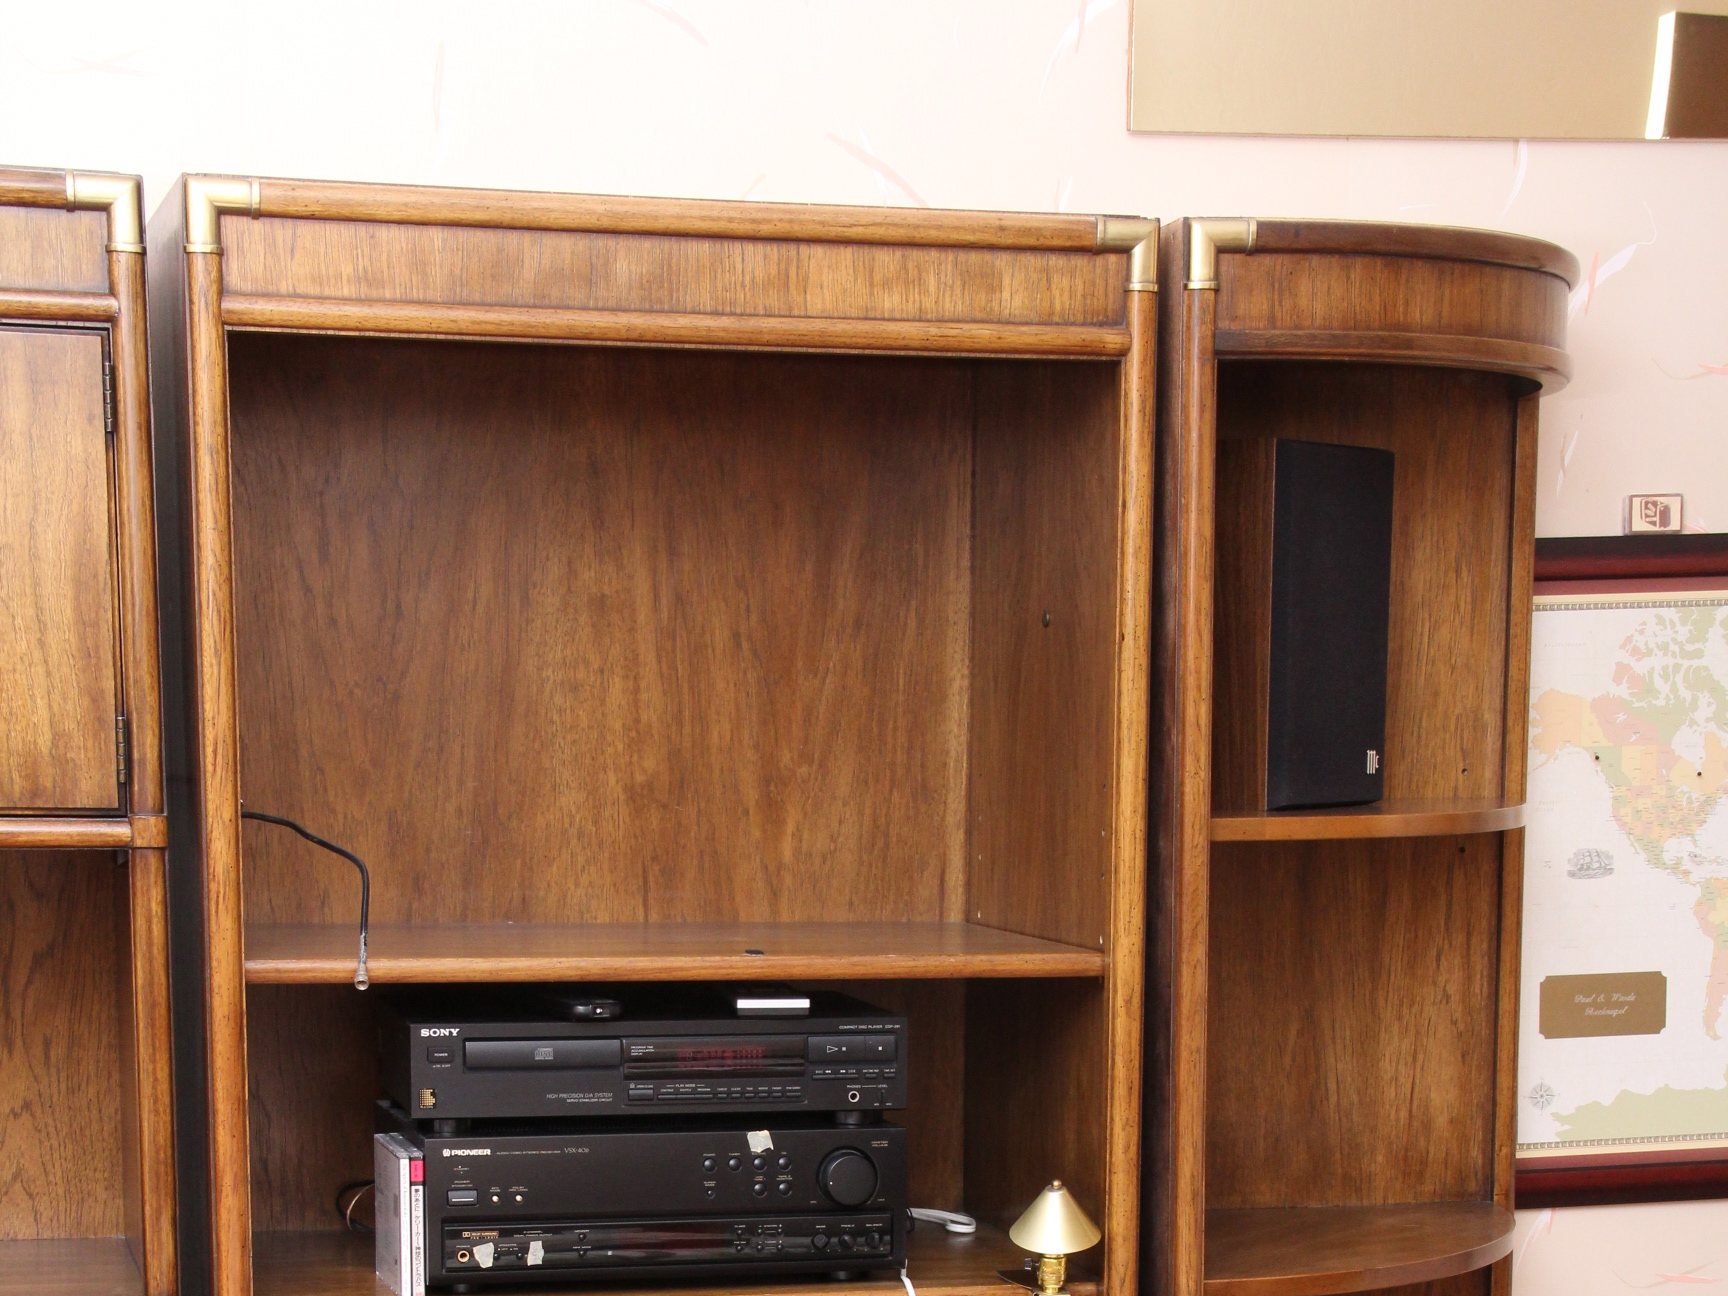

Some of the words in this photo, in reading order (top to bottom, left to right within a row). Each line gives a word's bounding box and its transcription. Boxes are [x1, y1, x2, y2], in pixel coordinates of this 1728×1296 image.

[1597, 994, 1606, 1003] &
[420, 1028, 460, 1037] SONY
[451, 1148, 492, 1156] PIONEER
